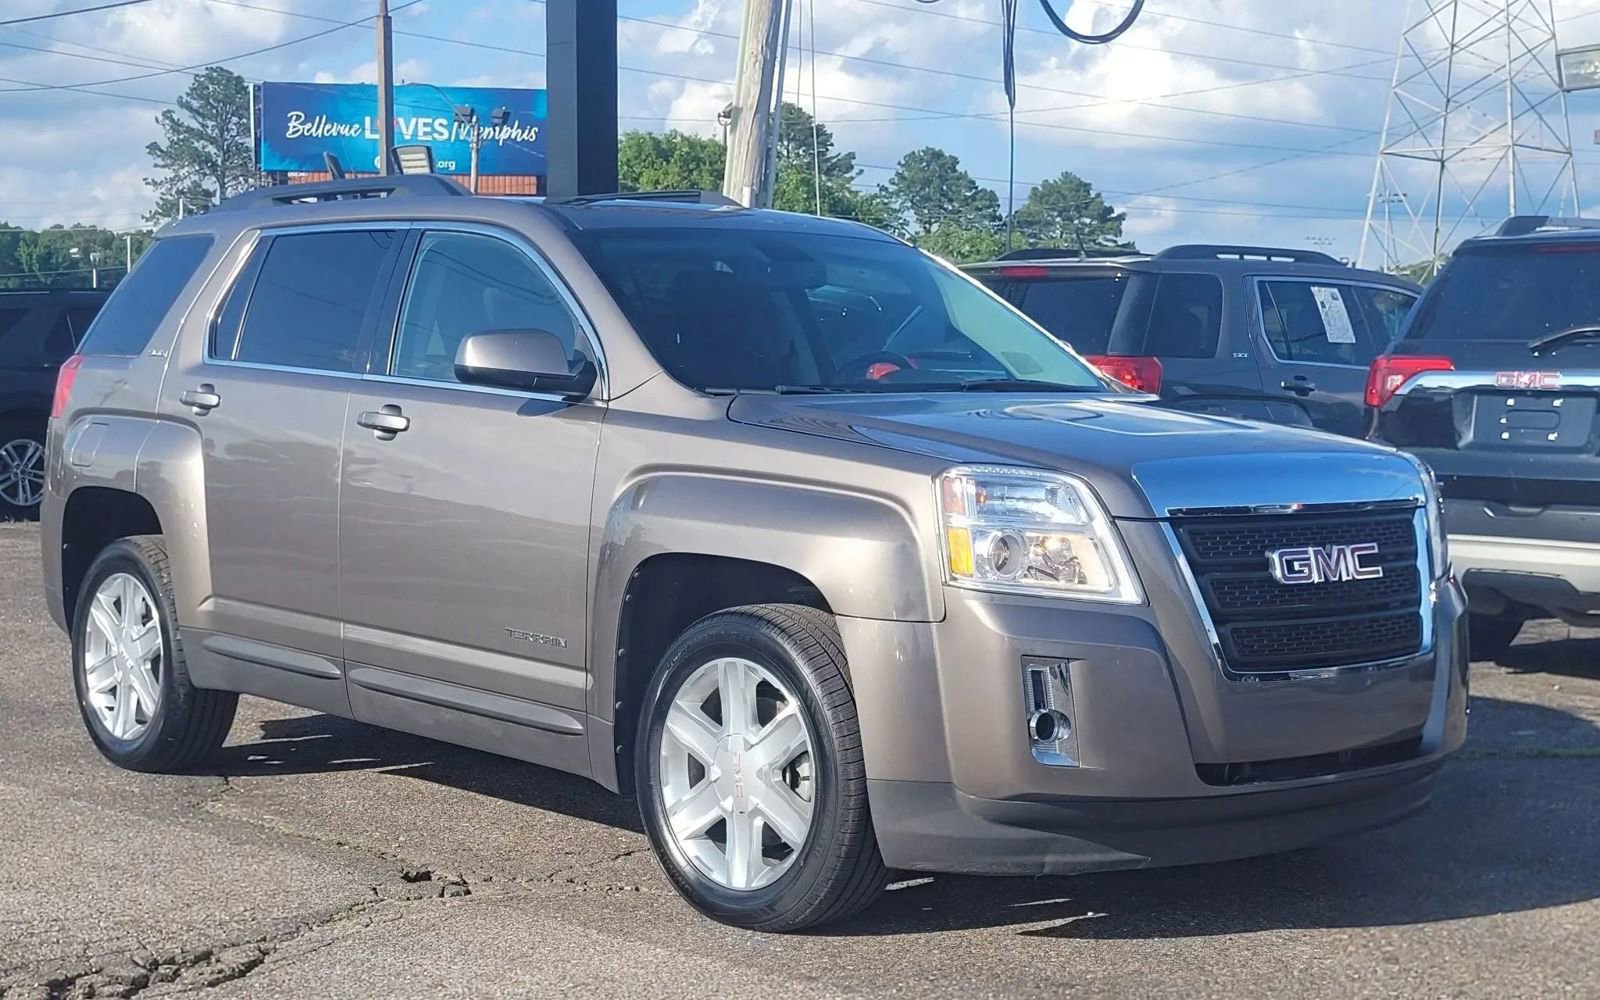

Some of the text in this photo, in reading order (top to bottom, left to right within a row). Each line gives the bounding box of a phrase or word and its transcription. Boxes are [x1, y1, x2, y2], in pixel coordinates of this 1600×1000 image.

[286, 111, 362, 138] Bellevue
[364, 115, 450, 141] LVES
[1496, 371, 1562, 391] GMC
[1266, 542, 1384, 584] GMC
[504, 626, 568, 649] TERRAIN
